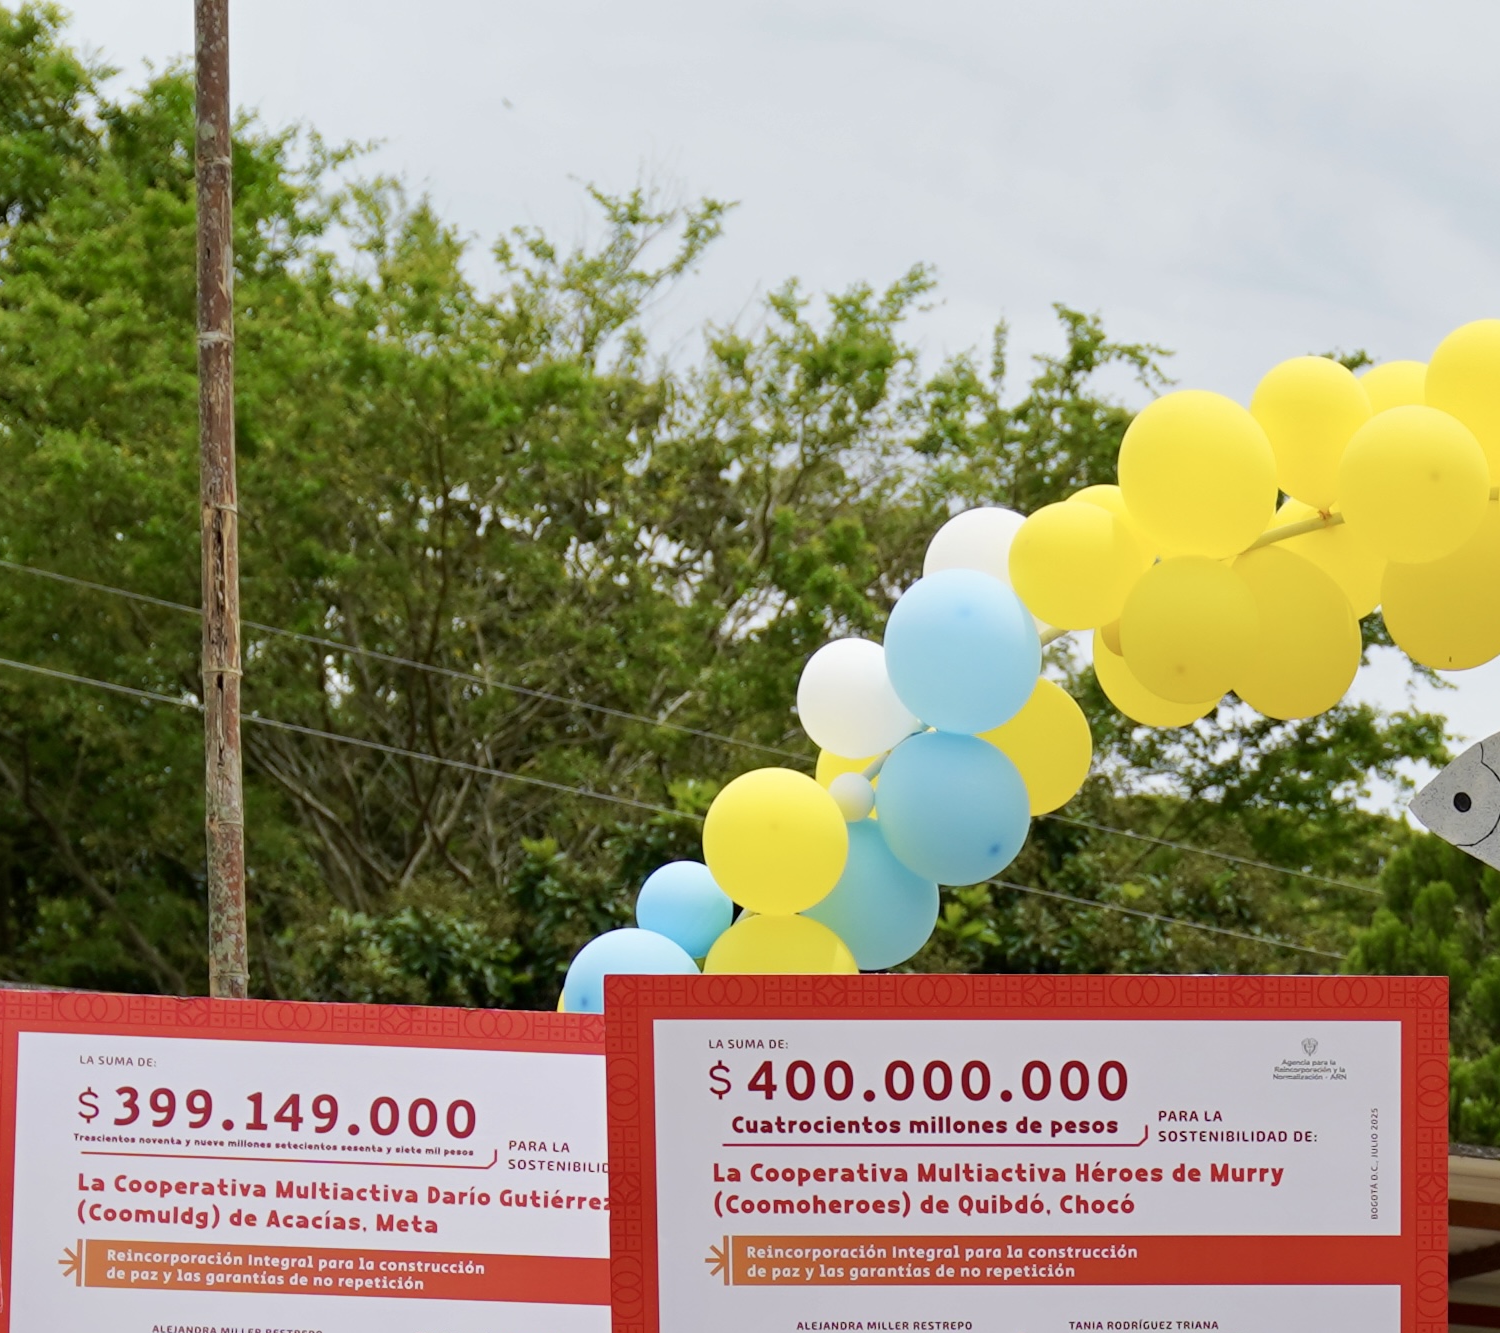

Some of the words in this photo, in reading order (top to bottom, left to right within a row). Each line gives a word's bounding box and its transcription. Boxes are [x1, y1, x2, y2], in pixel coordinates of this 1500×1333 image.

[79, 1055, 94, 1065] LA
[98, 1055, 134, 1066] SUMA
[73, 1132, 136, 1143] Trescientos
[138, 1136, 182, 1145] noventa
[185, 1139, 191, 1147] y
[227, 1139, 271, 1148] millones
[274, 1141, 337, 1151] setecientos
[340, 1144, 383, 1153] sesenta
[386, 1146, 392, 1154] y
[395, 1146, 422, 1154] siete
[425, 1147, 441, 1155] mil
[443, 1149, 474, 1157] pesos
[796, 1321, 863, 1331] ALEJANDRA
[866, 1321, 909, 1330] MILLER
[913, 1321, 972, 1330] RESTREPO
